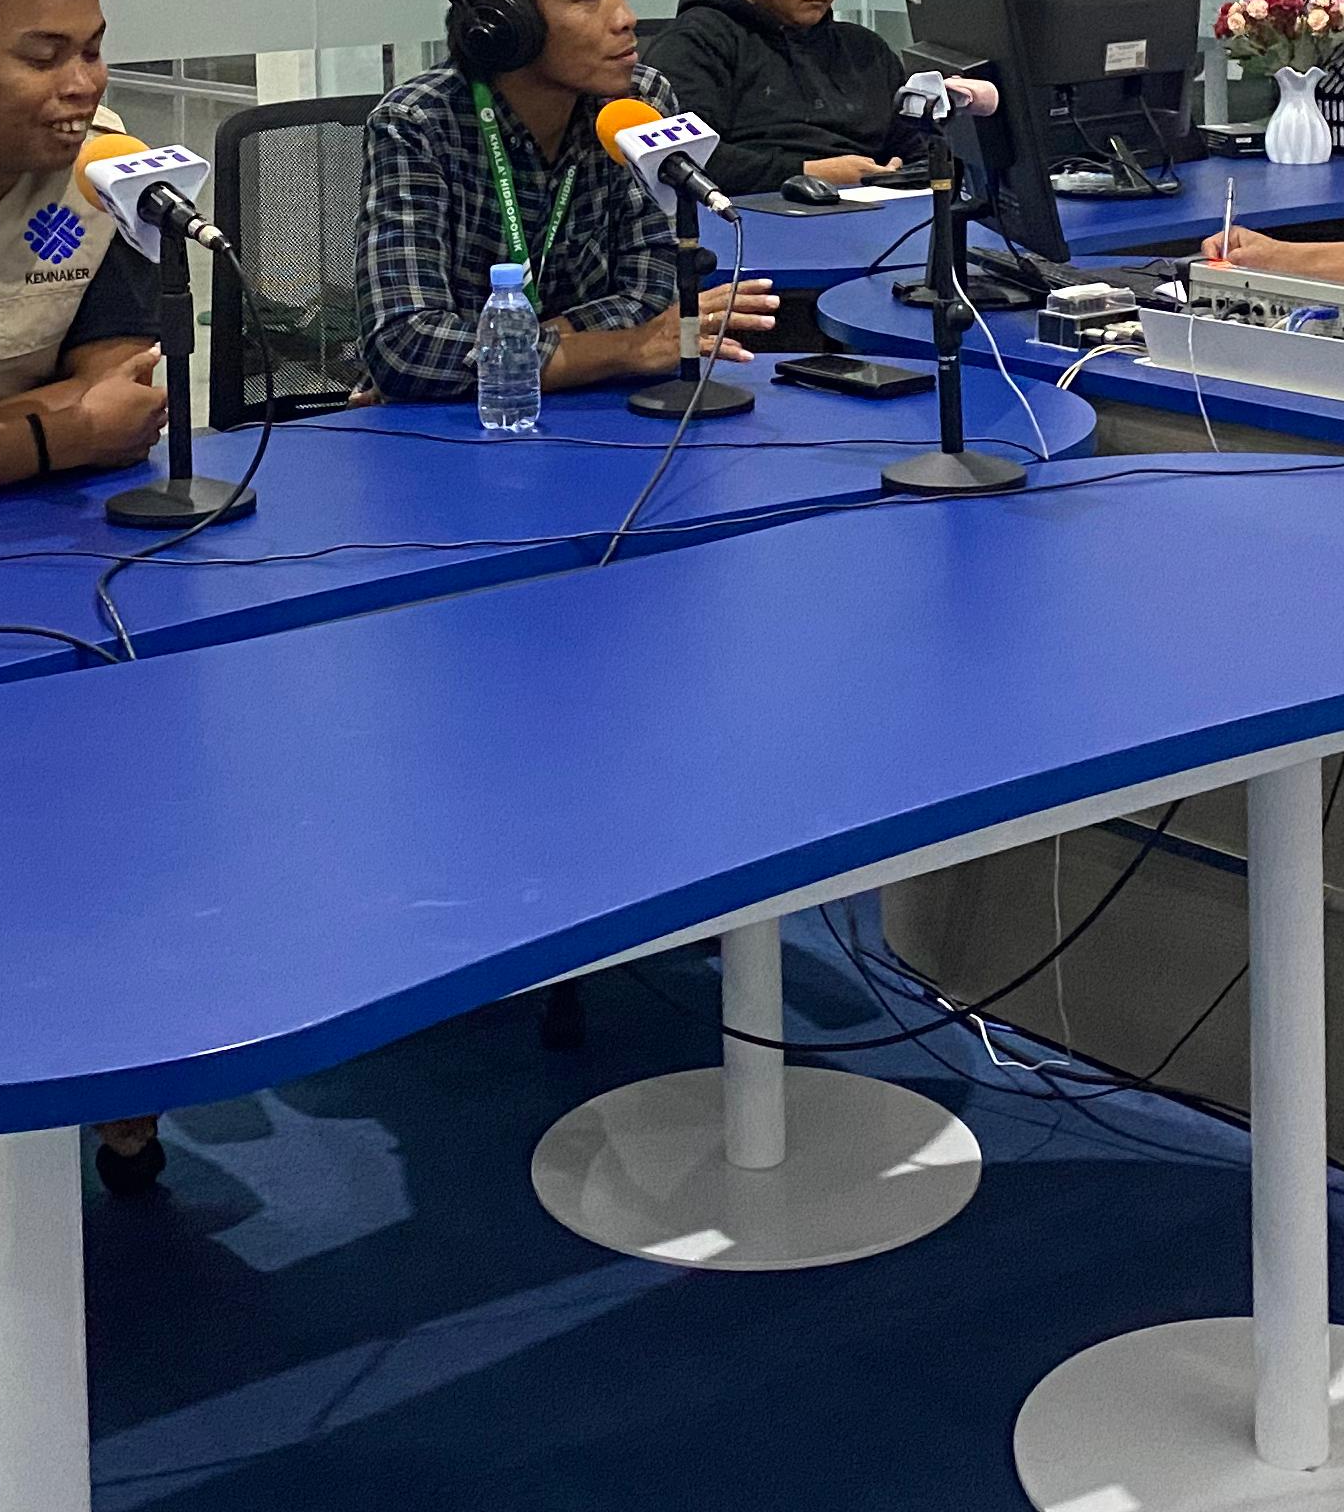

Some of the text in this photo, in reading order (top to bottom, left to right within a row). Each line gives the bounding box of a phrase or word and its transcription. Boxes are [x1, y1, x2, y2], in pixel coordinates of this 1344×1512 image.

[639, 117, 702, 148] rri
[114, 149, 191, 174] rri
[24, 268, 90, 285] KEMNAKER
